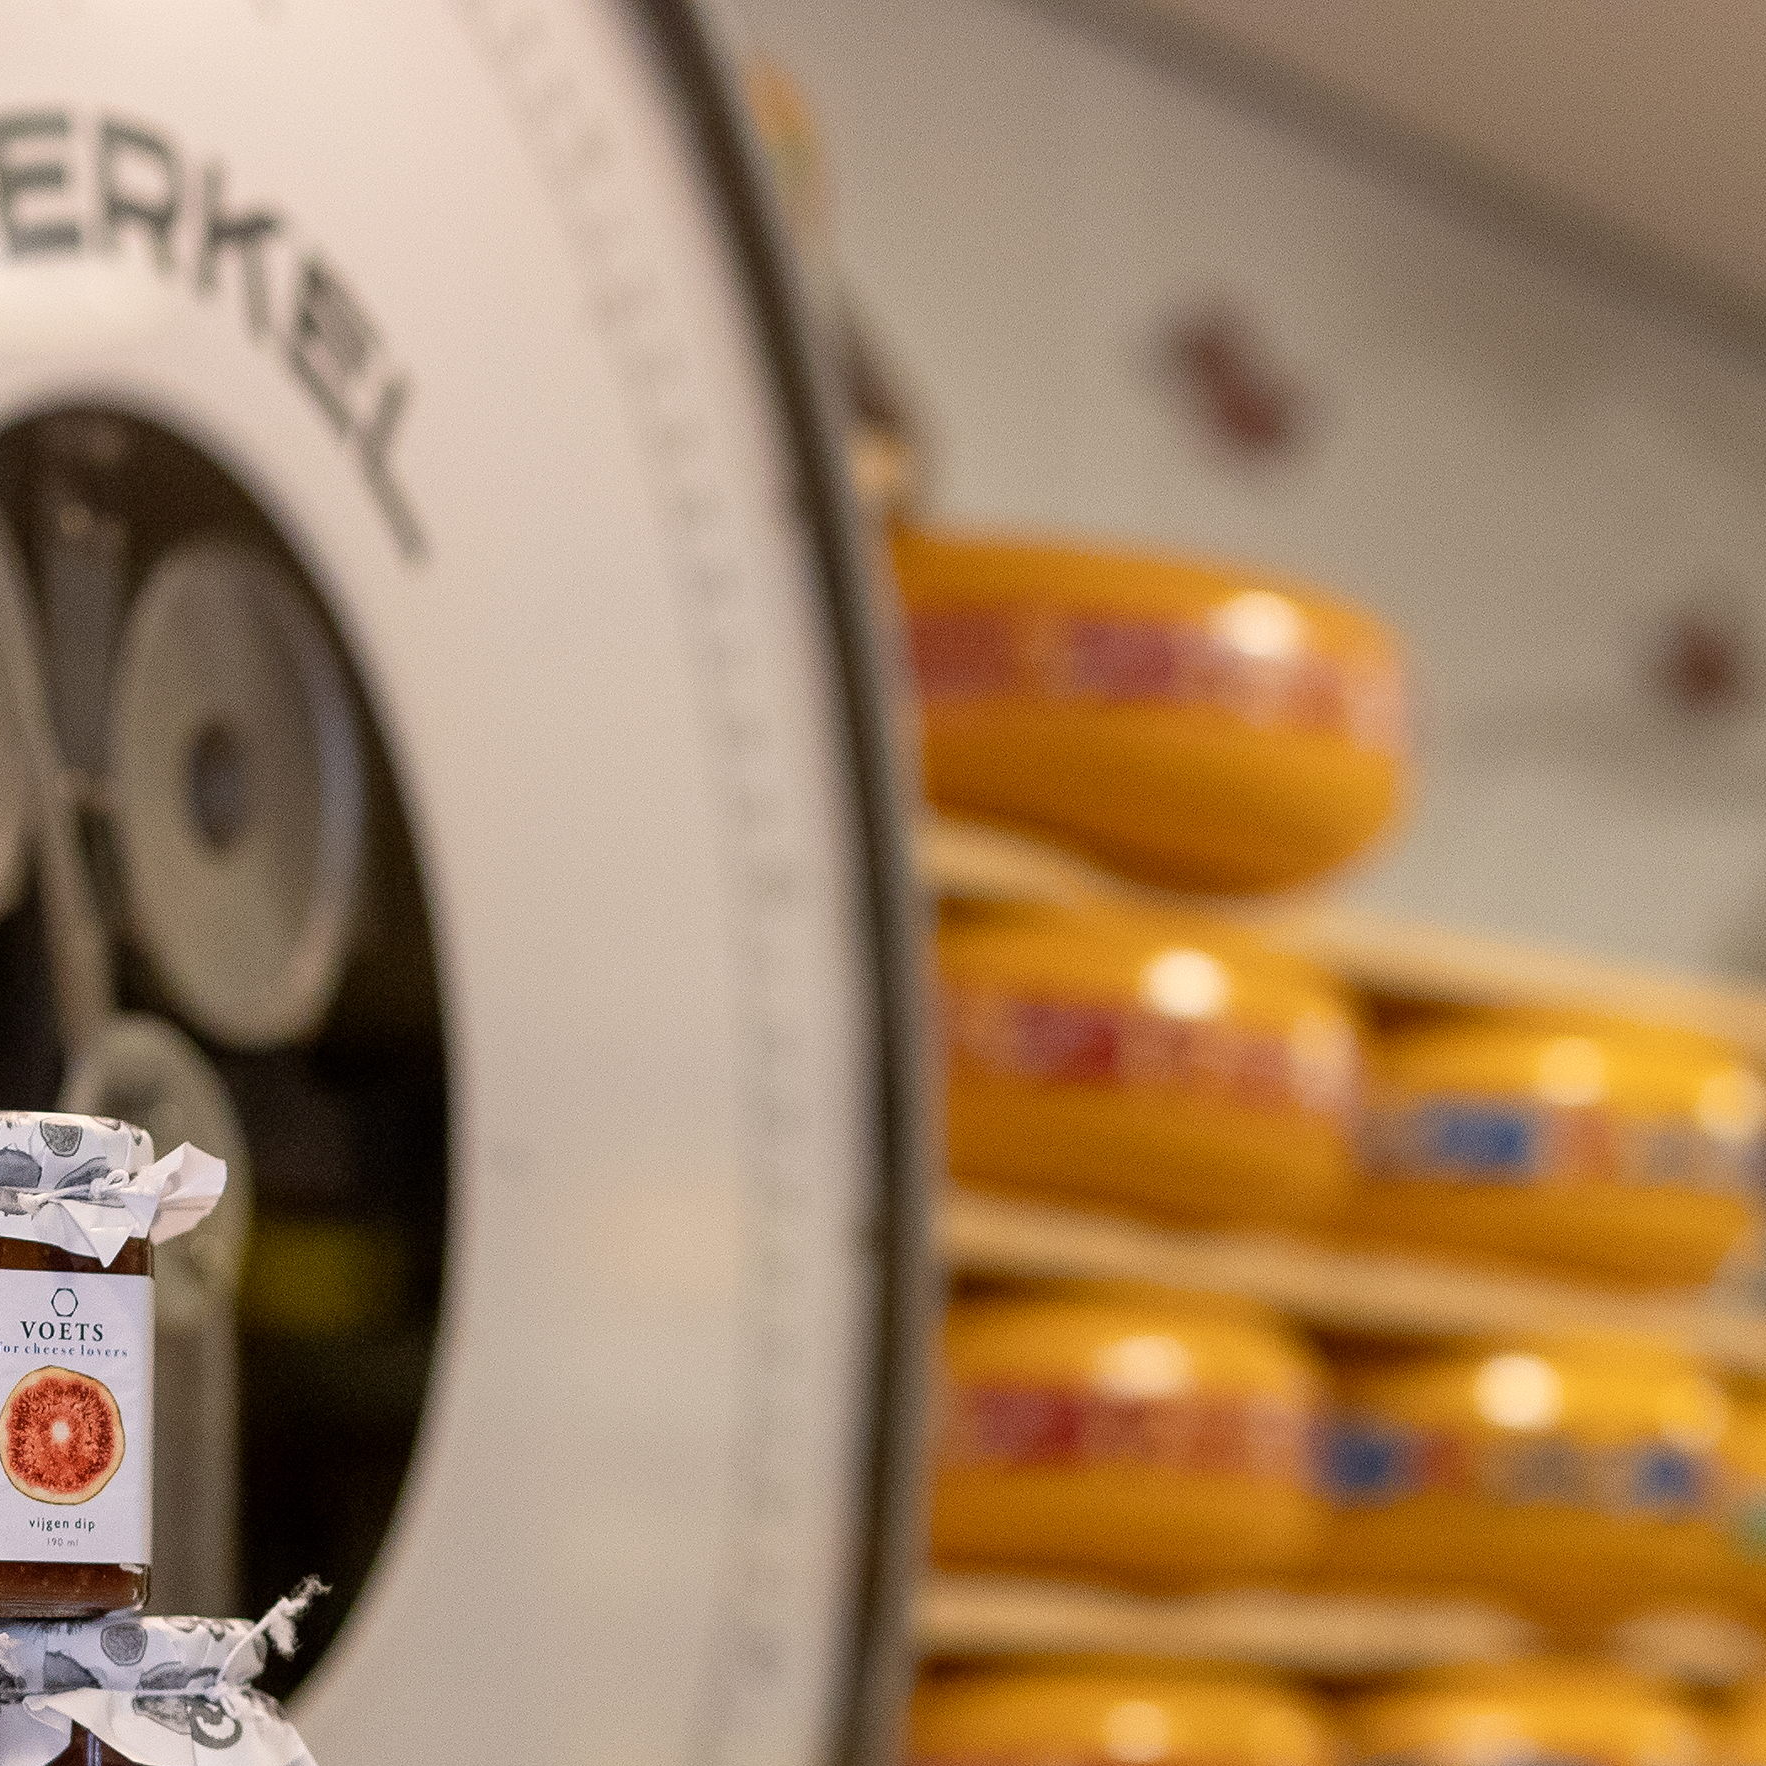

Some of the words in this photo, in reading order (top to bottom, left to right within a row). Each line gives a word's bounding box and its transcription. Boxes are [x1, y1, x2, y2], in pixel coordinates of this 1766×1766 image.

[20, 1320, 104, 1342] VOETS
[24, 1342, 74, 1356] cheese
[80, 1345, 128, 1357] lovers
[29, 1517, 69, 1532] vijgen
[74, 1518, 95, 1533] dip
